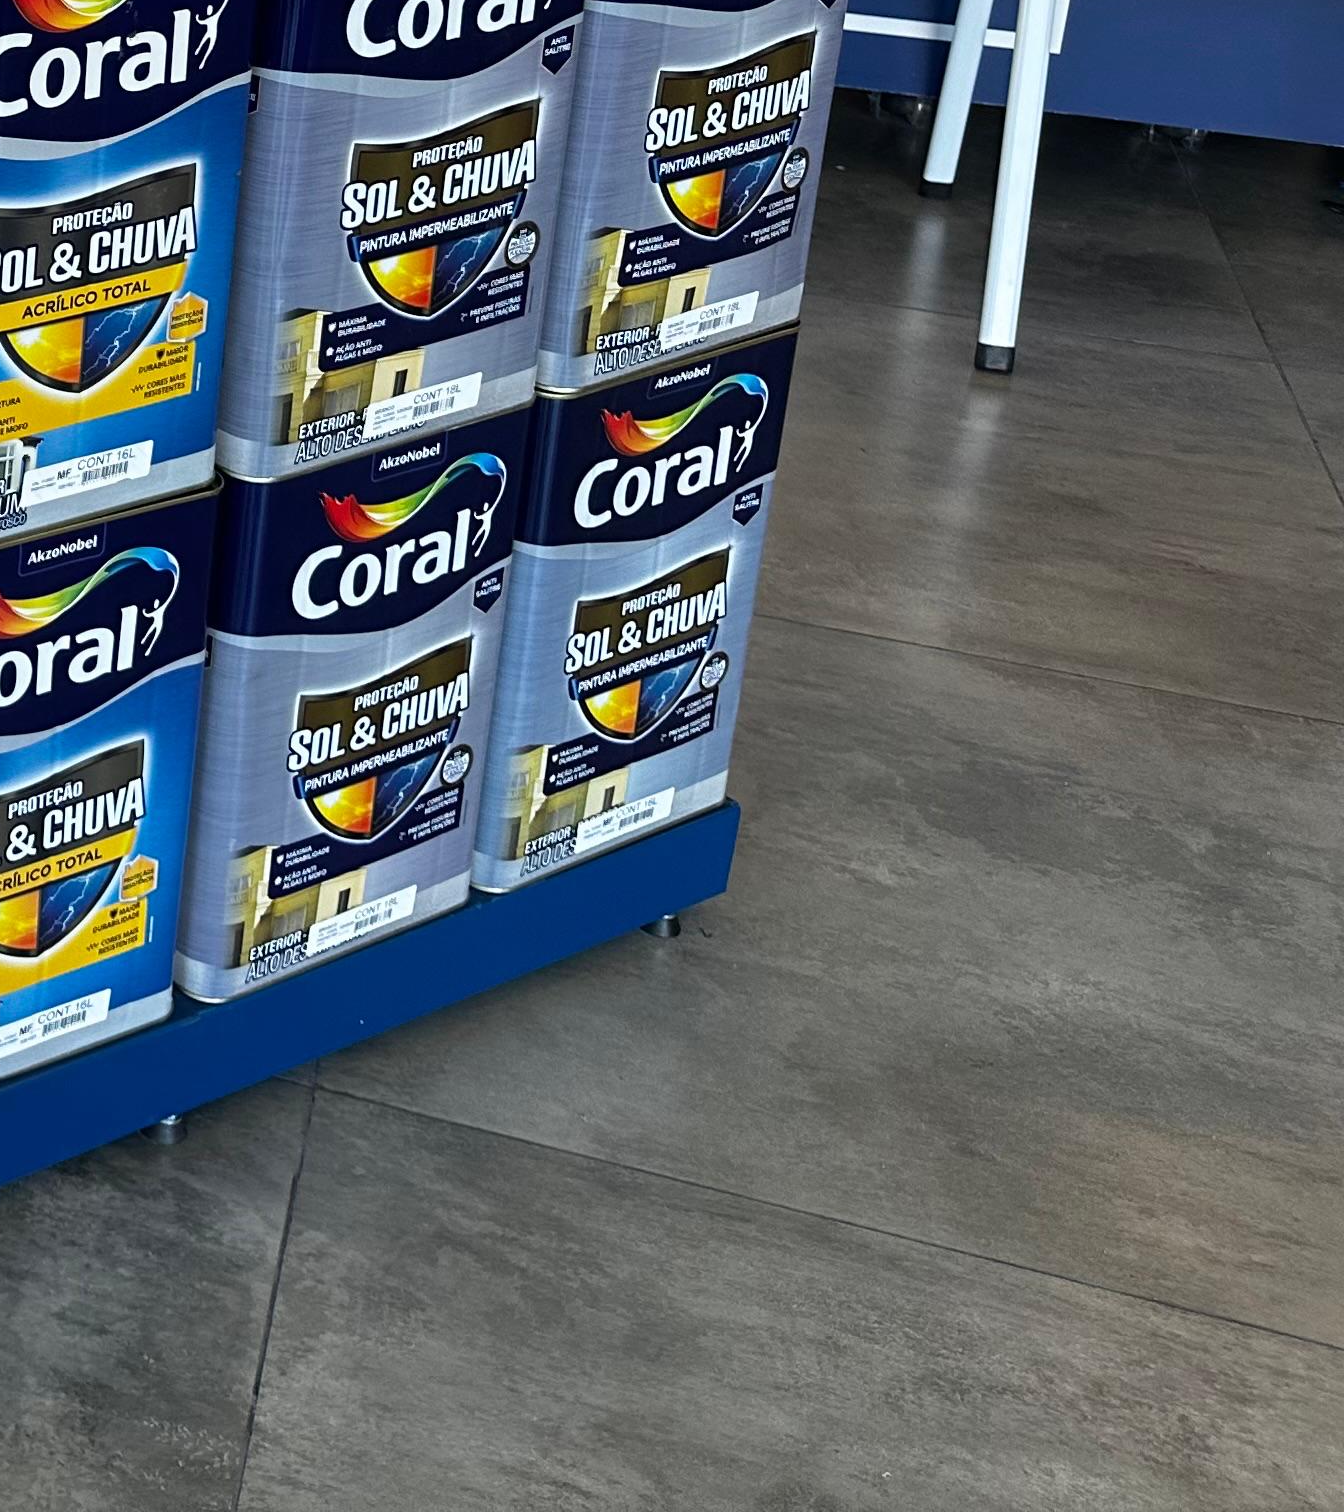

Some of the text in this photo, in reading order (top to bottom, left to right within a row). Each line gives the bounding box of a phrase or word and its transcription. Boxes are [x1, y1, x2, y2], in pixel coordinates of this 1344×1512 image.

[359, 199, 516, 256] PINTURA IMPERMEABILIZANTE
[574, 424, 733, 530] Coral
